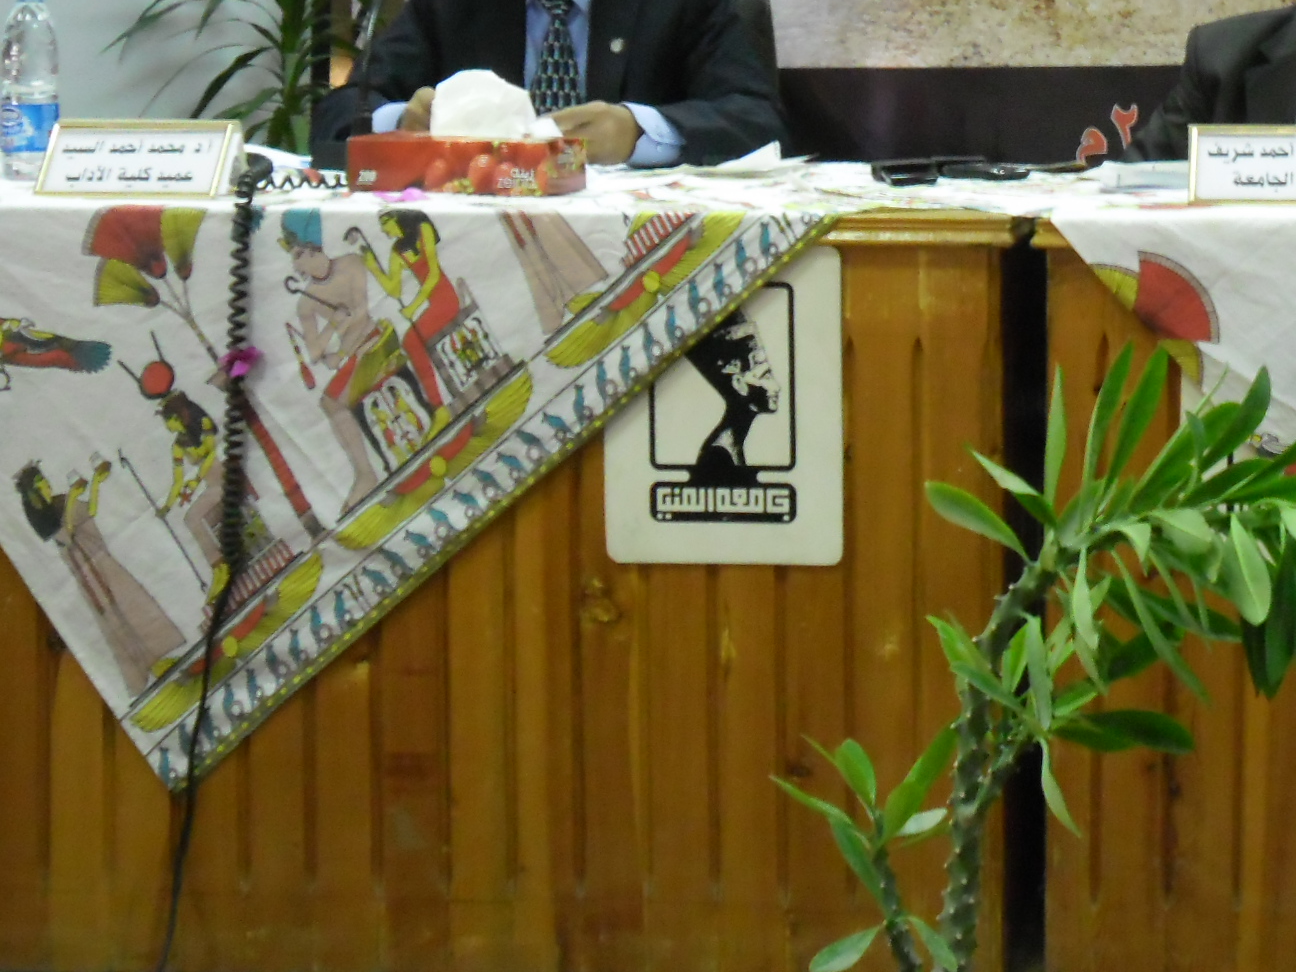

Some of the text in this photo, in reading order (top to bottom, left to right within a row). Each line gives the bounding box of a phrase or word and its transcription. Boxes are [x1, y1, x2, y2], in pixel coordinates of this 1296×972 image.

[147, 141, 186, 154] محمد
[1208, 142, 1255, 164] شريف
[117, 166, 153, 189] كلية
[156, 170, 193, 188] عميد
[1232, 171, 1294, 193] الجامعة
